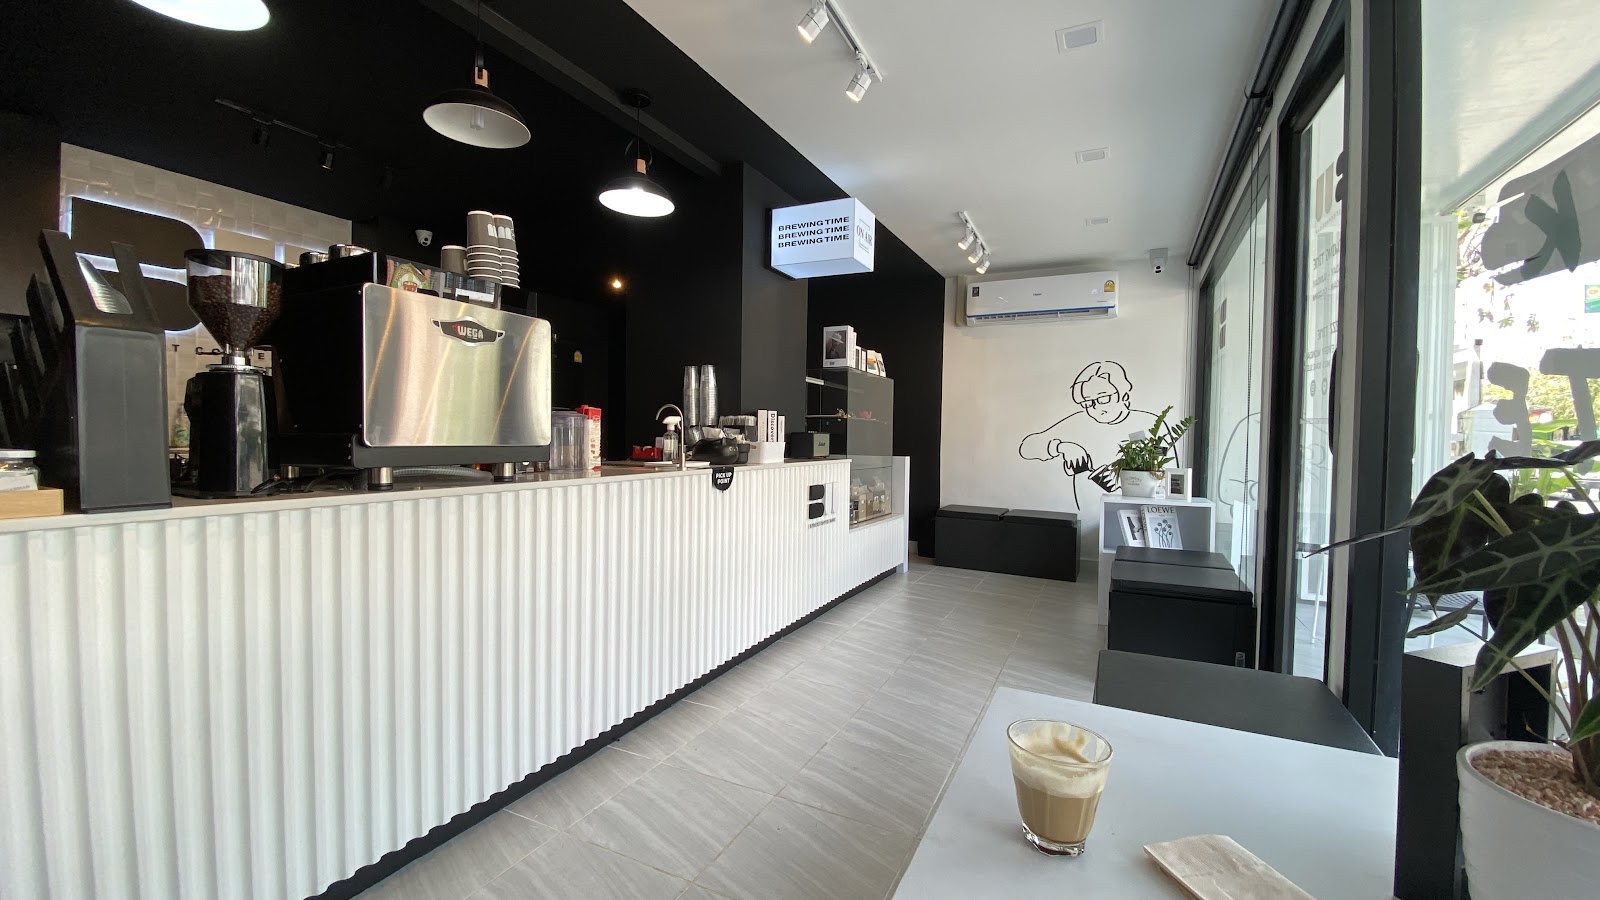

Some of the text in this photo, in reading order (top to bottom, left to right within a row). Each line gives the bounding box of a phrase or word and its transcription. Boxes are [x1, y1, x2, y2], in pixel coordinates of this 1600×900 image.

[778, 216, 850, 232] BREWING TIME
[778, 225, 850, 240] BREWING TIME
[856, 225, 873, 246] ON AIR
[778, 234, 849, 248] BREWING TIME
[457, 325, 484, 340] WEGA
[715, 471, 726, 479] PICK
[717, 477, 730, 485] POINT
[1147, 506, 1175, 514] LOEWE
